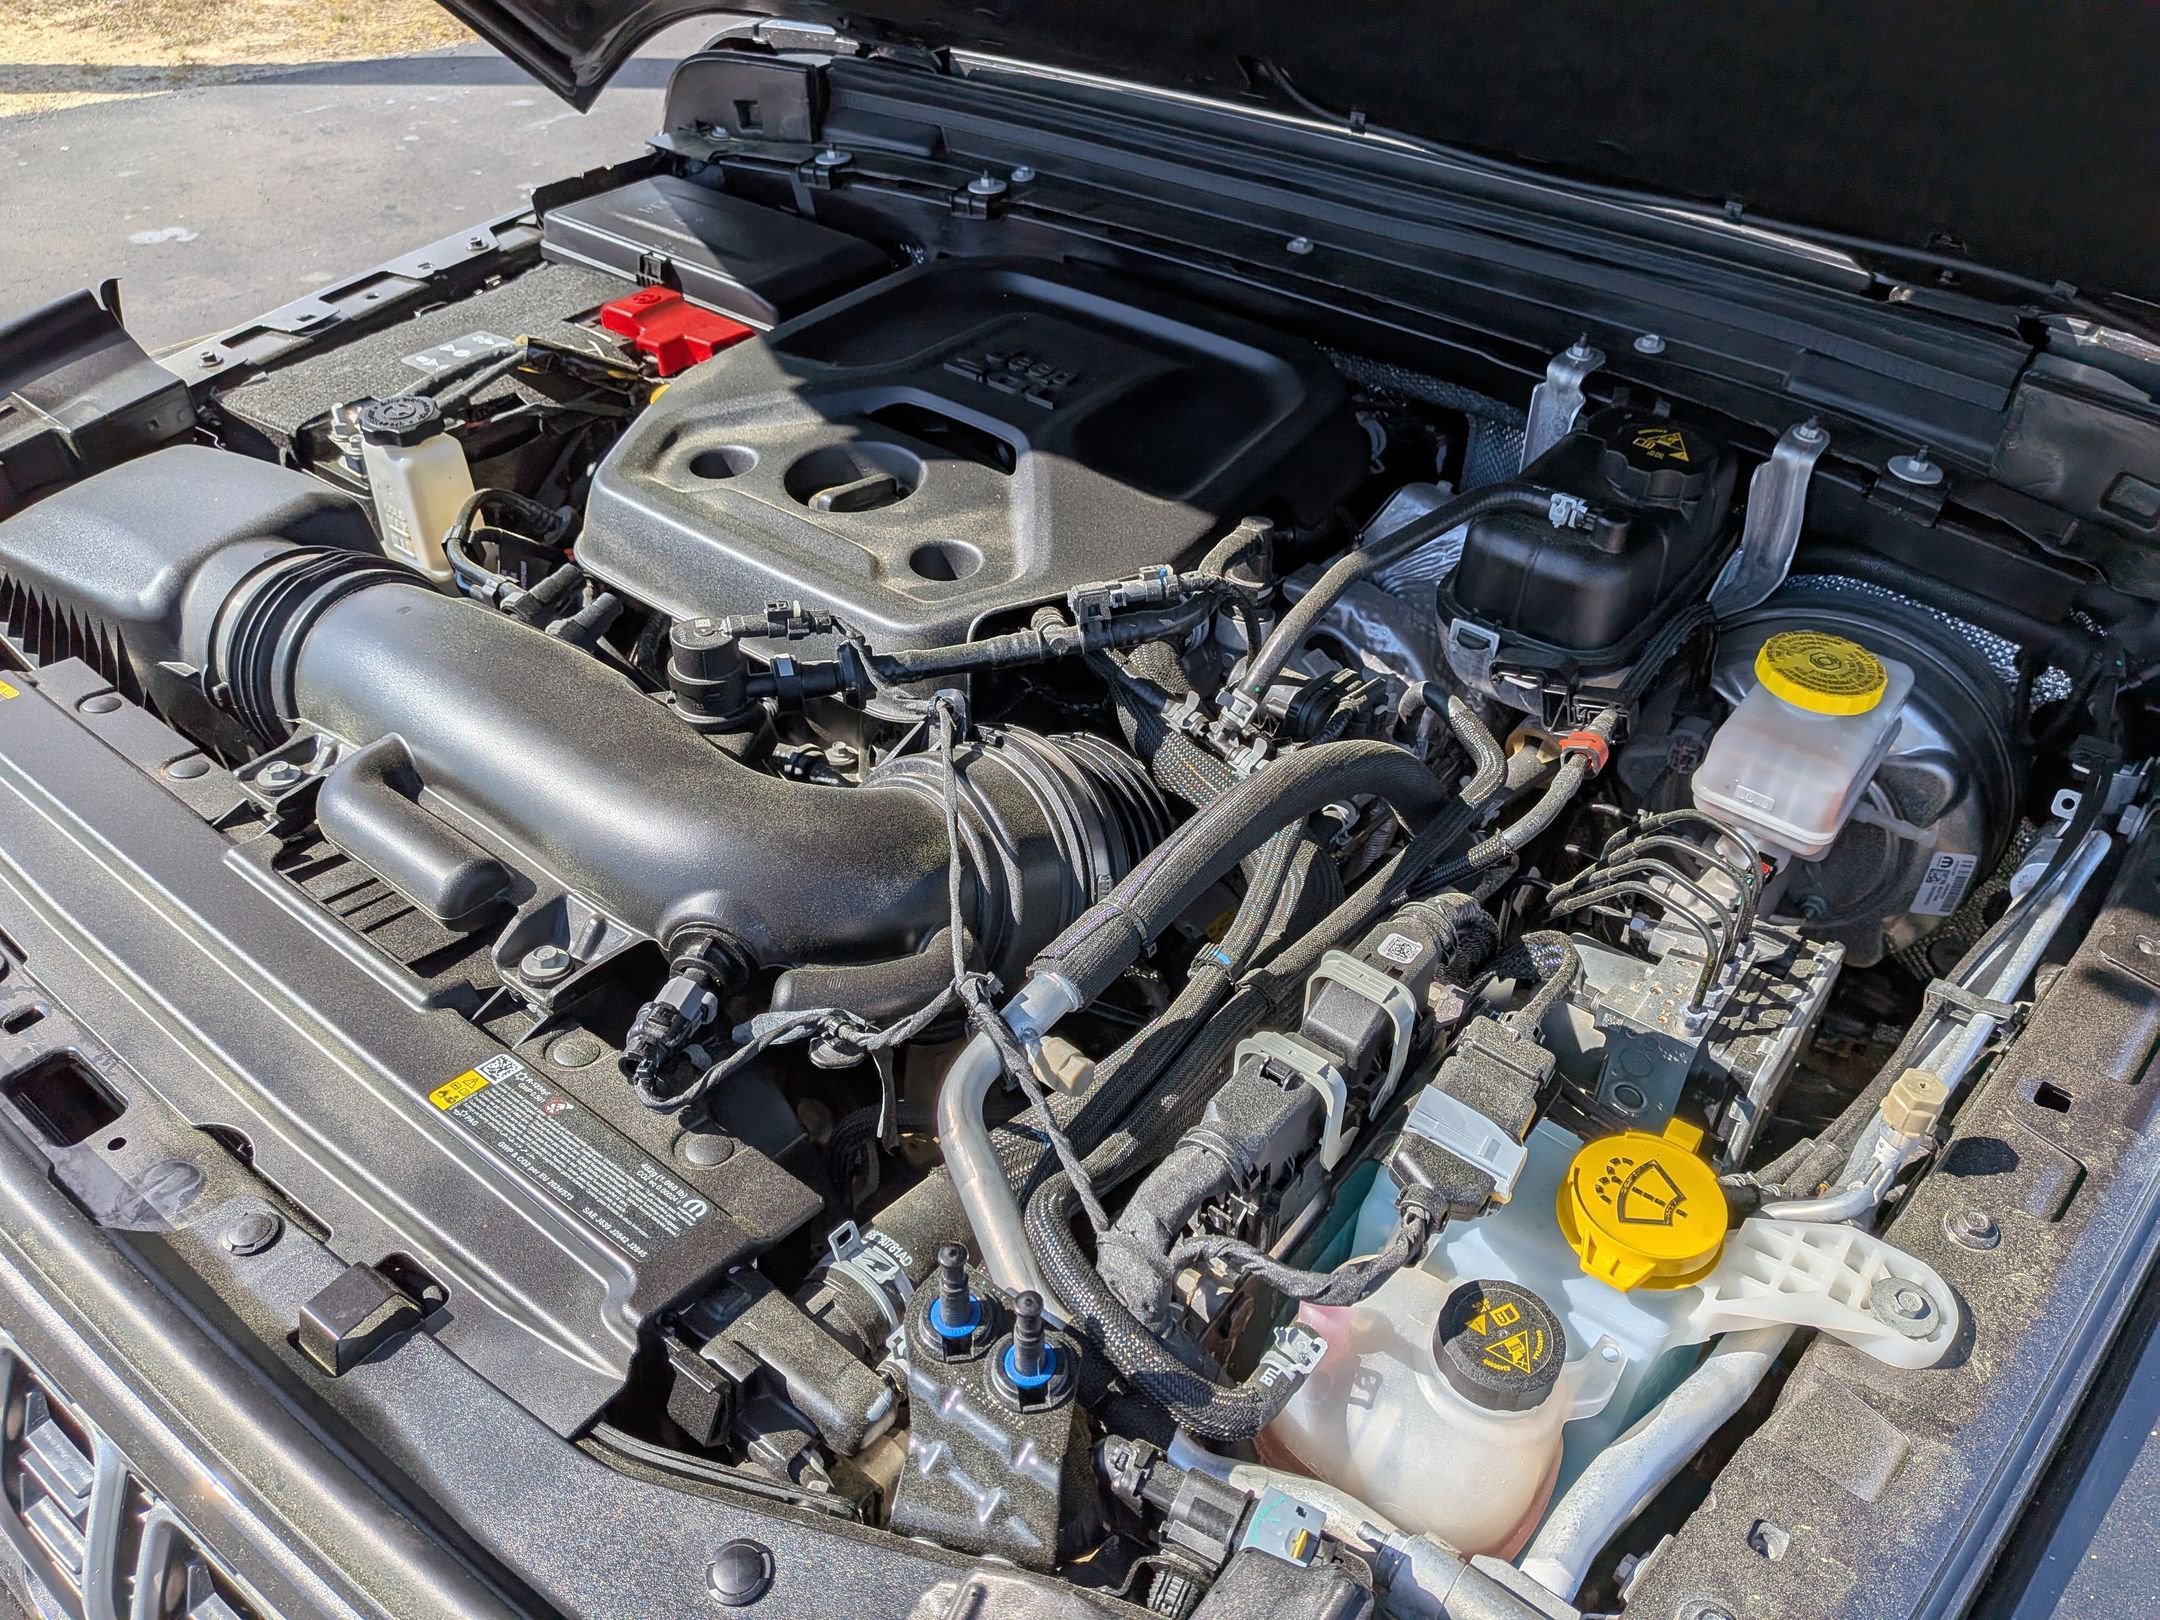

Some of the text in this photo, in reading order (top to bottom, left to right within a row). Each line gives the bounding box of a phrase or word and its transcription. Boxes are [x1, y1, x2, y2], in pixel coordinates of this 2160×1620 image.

[516, 1081, 534, 1094] GWP
[463, 1114, 480, 1127] PAG
[495, 1140, 514, 1154] GWP
[515, 1155, 532, 1168] CO2
[526, 1164, 541, 1176] per
[537, 1172, 550, 1182] EU
[580, 1205, 599, 1220] SAE
